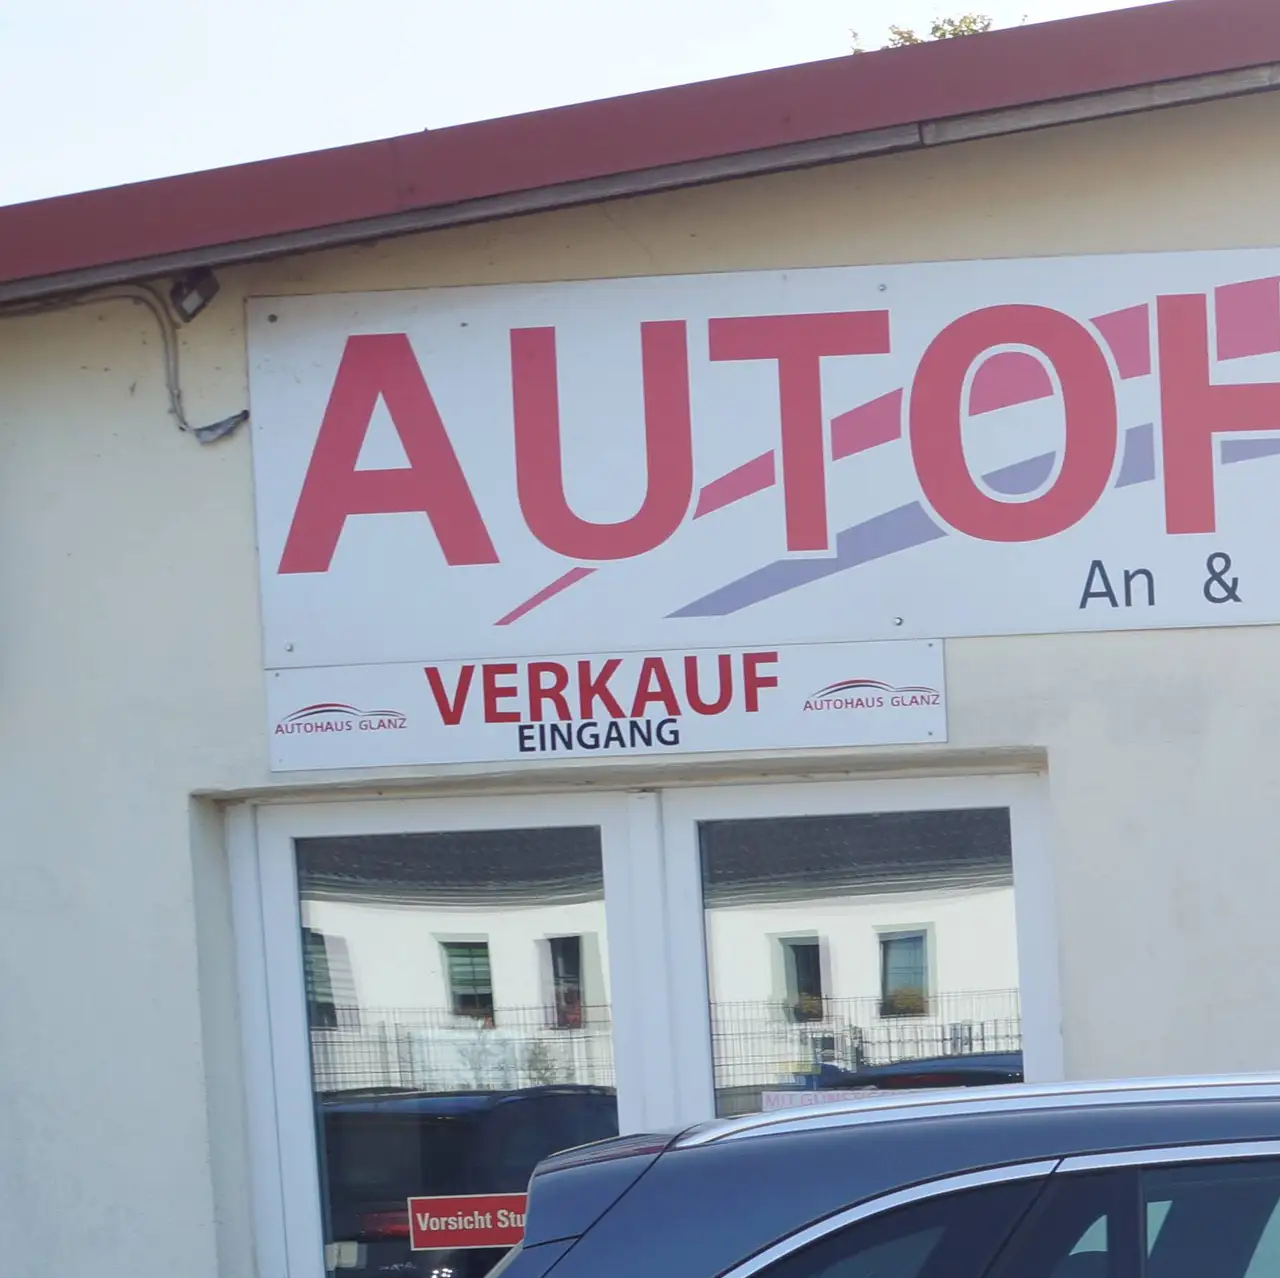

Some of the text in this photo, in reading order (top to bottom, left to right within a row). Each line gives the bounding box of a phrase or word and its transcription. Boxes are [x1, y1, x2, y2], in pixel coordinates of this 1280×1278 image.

[1079, 558, 1156, 609] An
[1202, 551, 1243, 604] &
[423, 651, 779, 726] VERKAUF
[803, 693, 941, 712] AUTOHAUS GLANZ
[274, 717, 408, 735] AUTOHAUS GLANZ
[517, 717, 680, 753] EINGANG
[416, 1210, 492, 1231] Vorsicht
